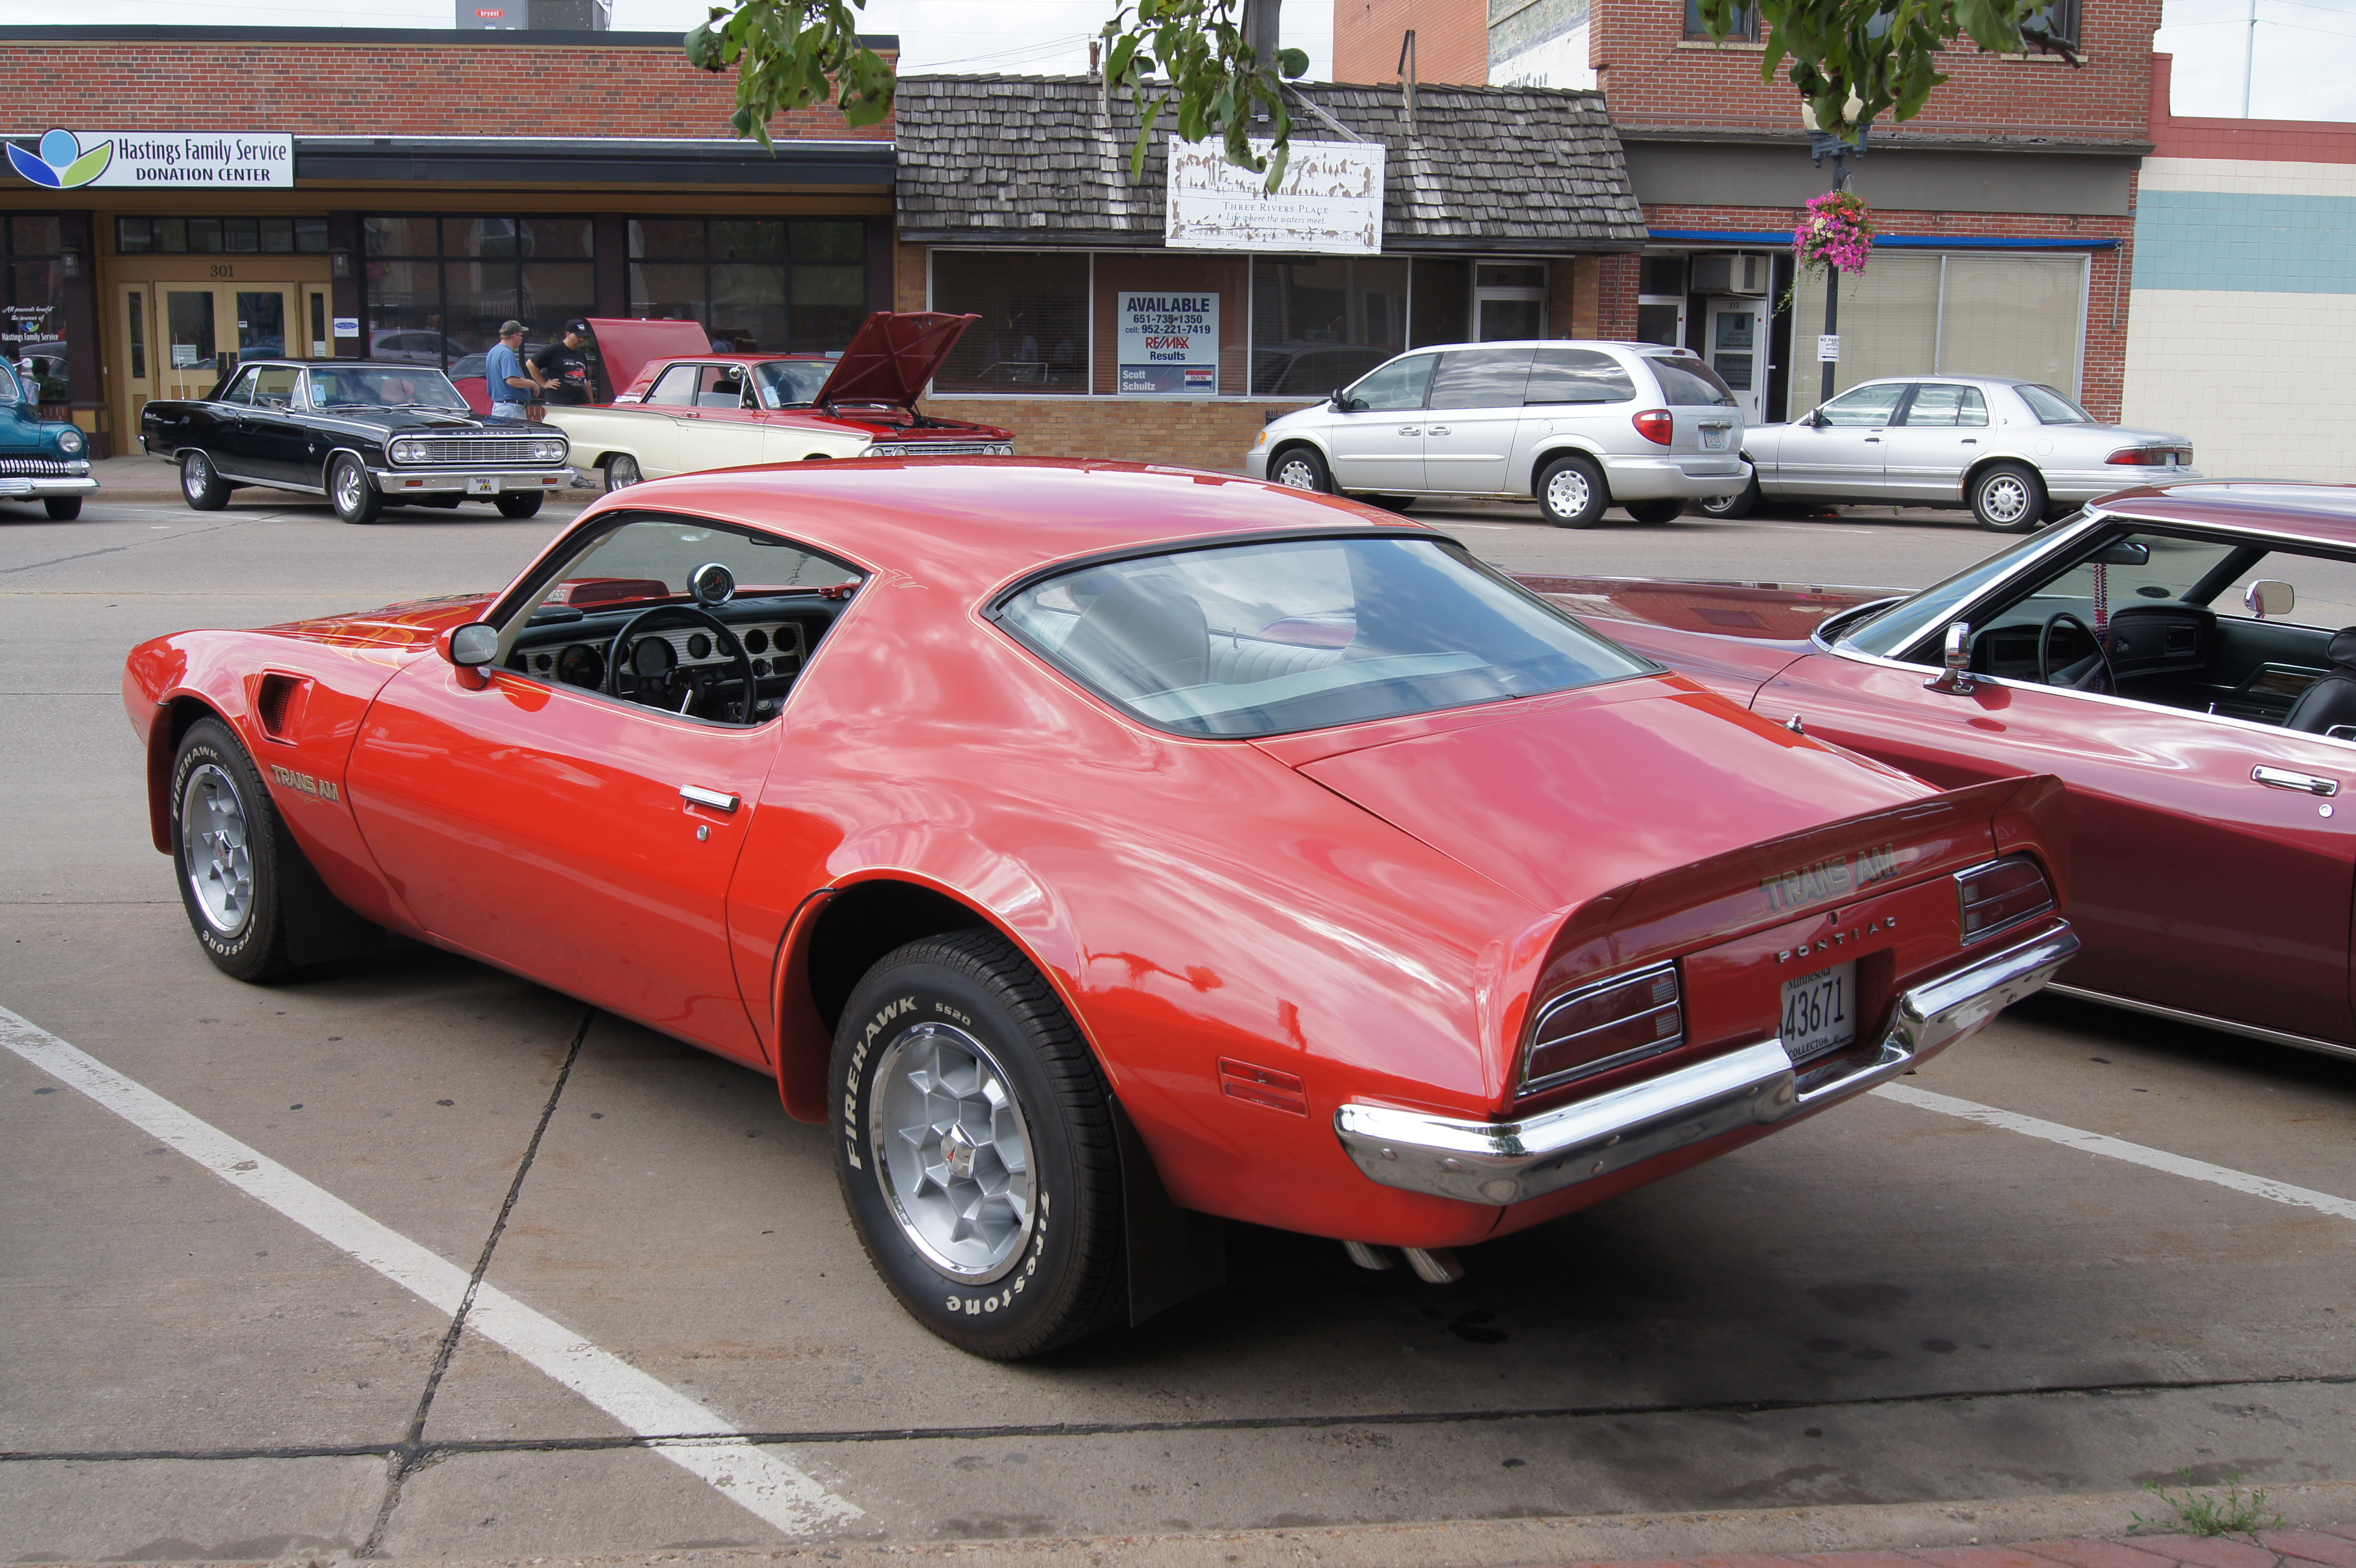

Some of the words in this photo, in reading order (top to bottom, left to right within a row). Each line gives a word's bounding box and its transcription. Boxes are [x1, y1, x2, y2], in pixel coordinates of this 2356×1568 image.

[119, 139, 181, 165] Hastings
[185, 139, 231, 165] Family
[237, 139, 287, 161] Service
[136, 168, 212, 181] DONATION
[219, 168, 271, 181] CENTER
[1226, 212, 1240, 223] Life
[1243, 213, 1265, 222] where
[1312, 233, 1359, 242] SHOWROOM
[210, 265, 234, 277] 301
[35, 306, 55, 315] benefit
[1127, 298, 1209, 312] AVAILABLE
[38, 315, 45, 323] of
[1142, 325, 1211, 334] 952-221-7419
[2, 332, 23, 342] Hastings
[24, 332, 40, 342] Family
[41, 332, 58, 341] Service
[1146, 337, 1189, 349] RE/MAX
[1150, 351, 1186, 360] Results
[1123, 370, 1146, 379] Scott
[1123, 382, 1155, 390] Schultz
[173, 746, 219, 821] FIREHAWK
[271, 764, 316, 794] TRANS
[318, 779, 339, 802] AM
[1761, 856, 1851, 912] TRANS
[1856, 843, 1898, 886] AM
[203, 913, 257, 957] Firestone
[1778, 916, 1896, 963] PONTIAC
[1779, 976, 1844, 1041] 43671
[1789, 1035, 1829, 1057] COLLECTOR
[845, 996, 917, 1170] FIREHAWK
[947, 1191, 1051, 1315] Firestone
